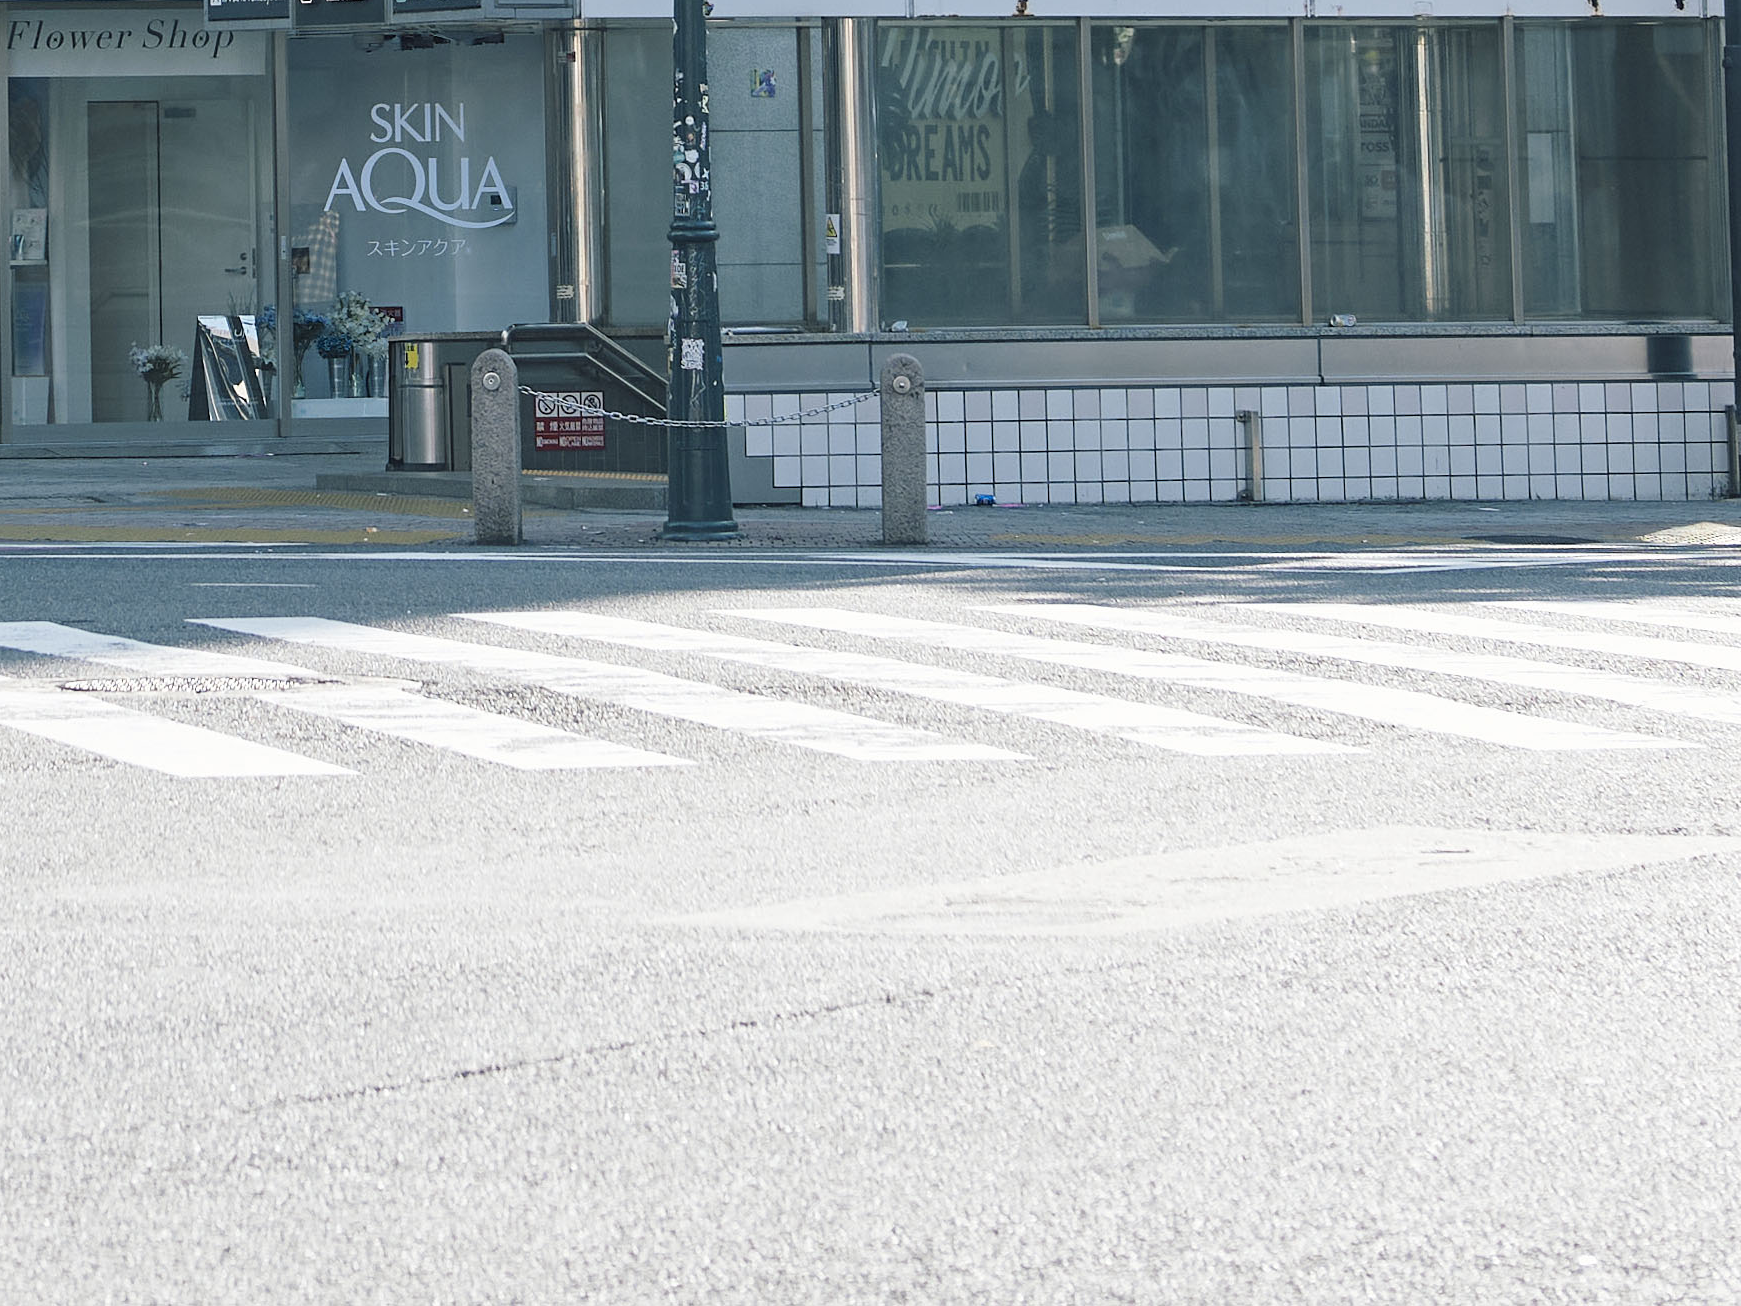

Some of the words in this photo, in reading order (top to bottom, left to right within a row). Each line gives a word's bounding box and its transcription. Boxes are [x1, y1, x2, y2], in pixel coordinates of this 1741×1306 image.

[5, 18, 134, 55] Flower
[141, 19, 237, 59] Shop
[370, 102, 466, 143] SKIN
[324, 146, 516, 229] AQUA
[367, 237, 468, 258] スキンアクア
